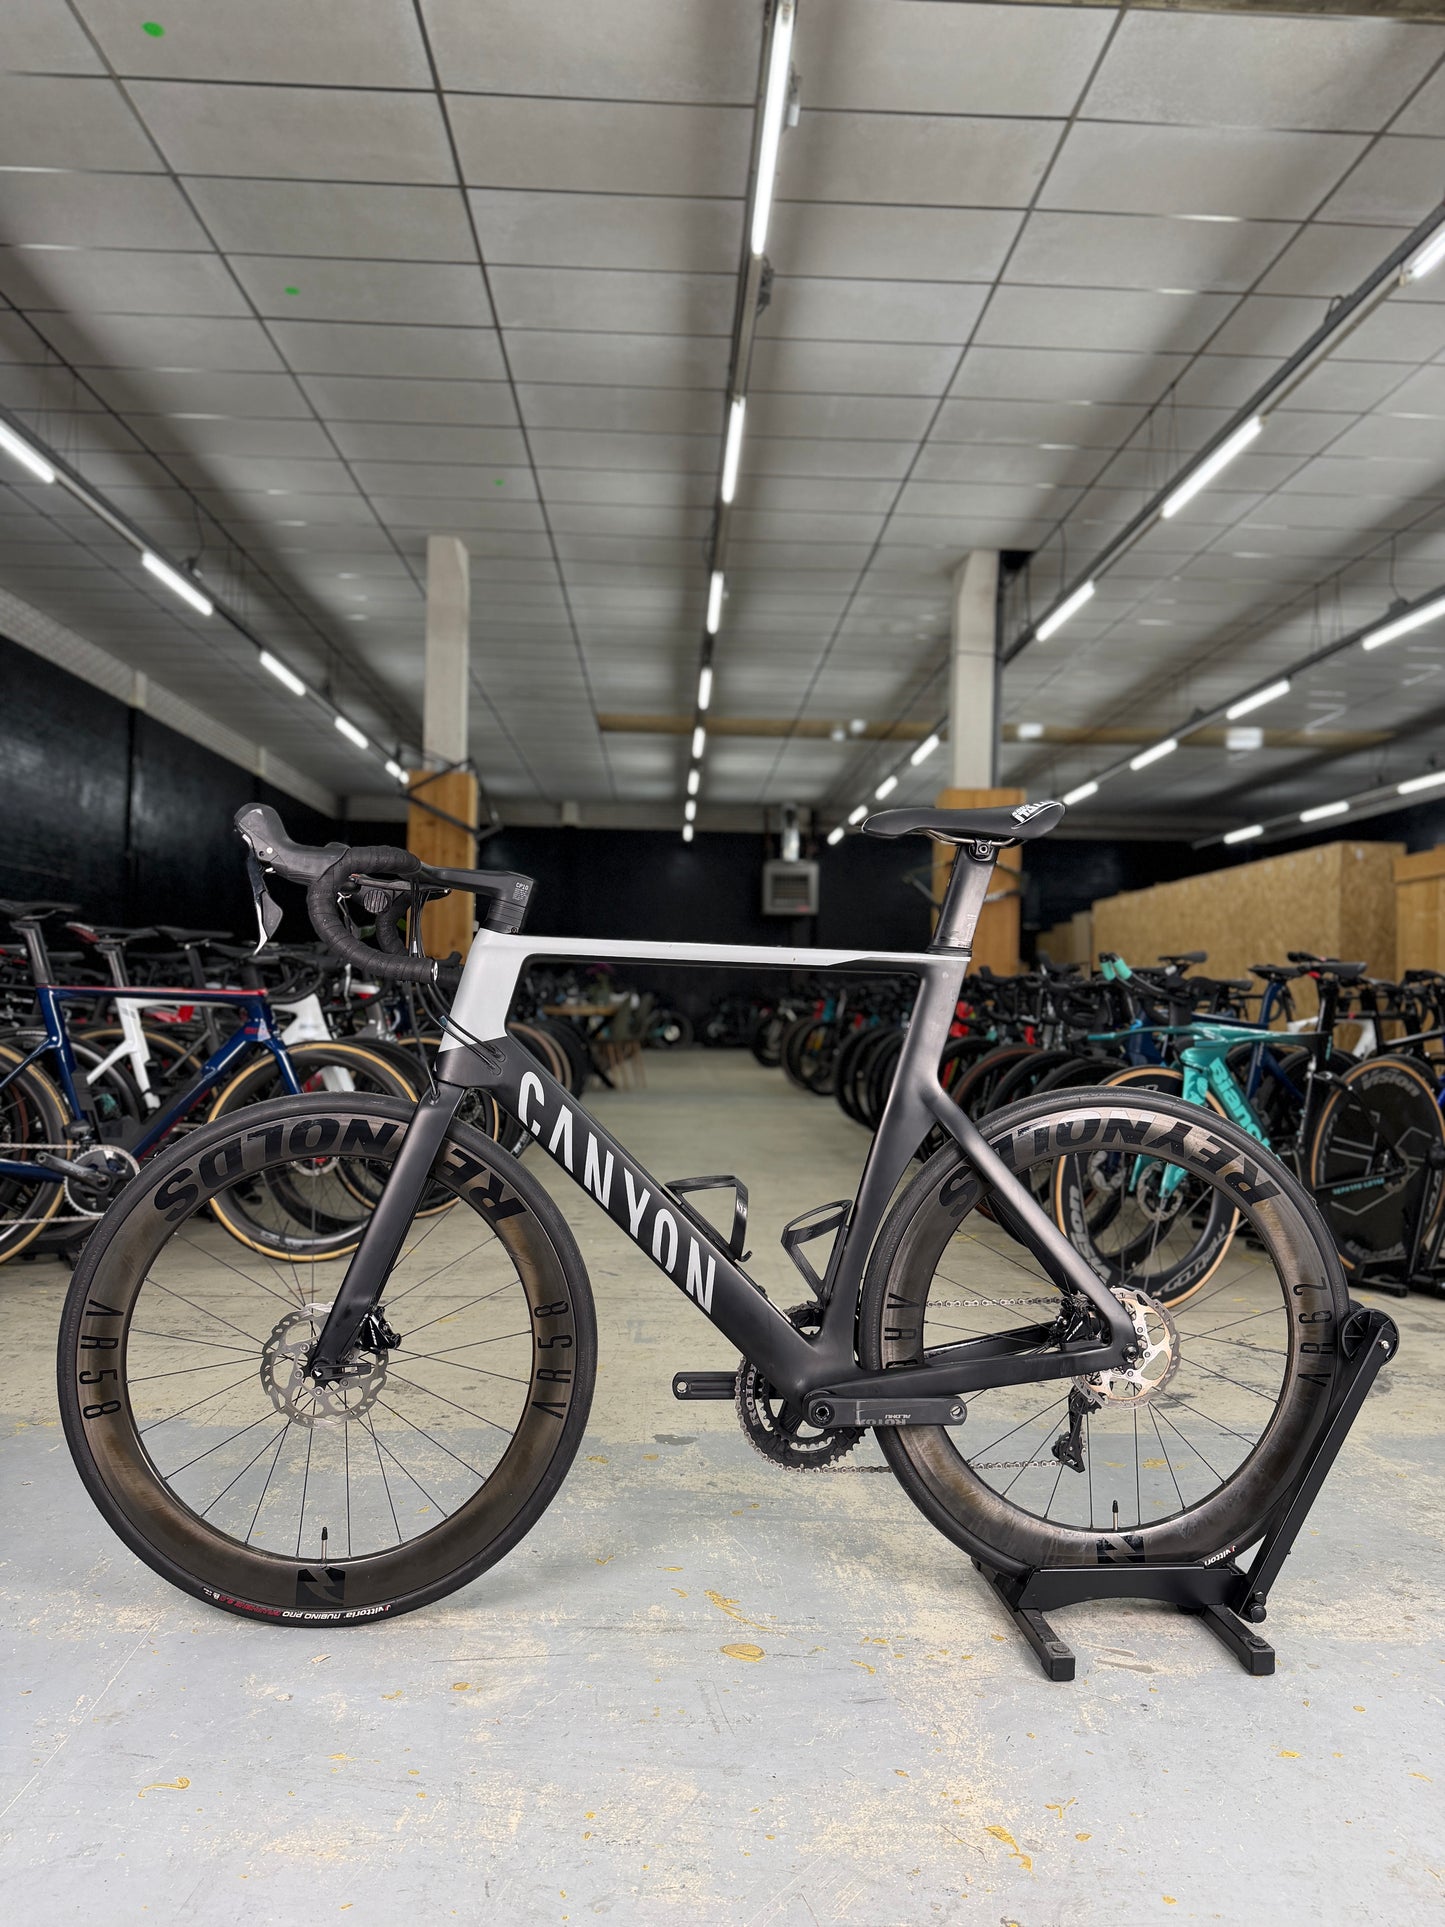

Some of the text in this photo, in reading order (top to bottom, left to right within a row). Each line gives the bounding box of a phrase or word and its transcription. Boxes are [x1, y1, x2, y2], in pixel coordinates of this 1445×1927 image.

[1209, 1057, 1282, 1162] Bianc
[154, 1118, 528, 1222] RENOLDS
[518, 1071, 716, 1315] CANYON
[79, 1298, 124, 1419] AR58
[531, 1300, 573, 1420] AR58
[282, 1611, 302, 1619] PRO
[304, 1612, 341, 1620] RUBINO
